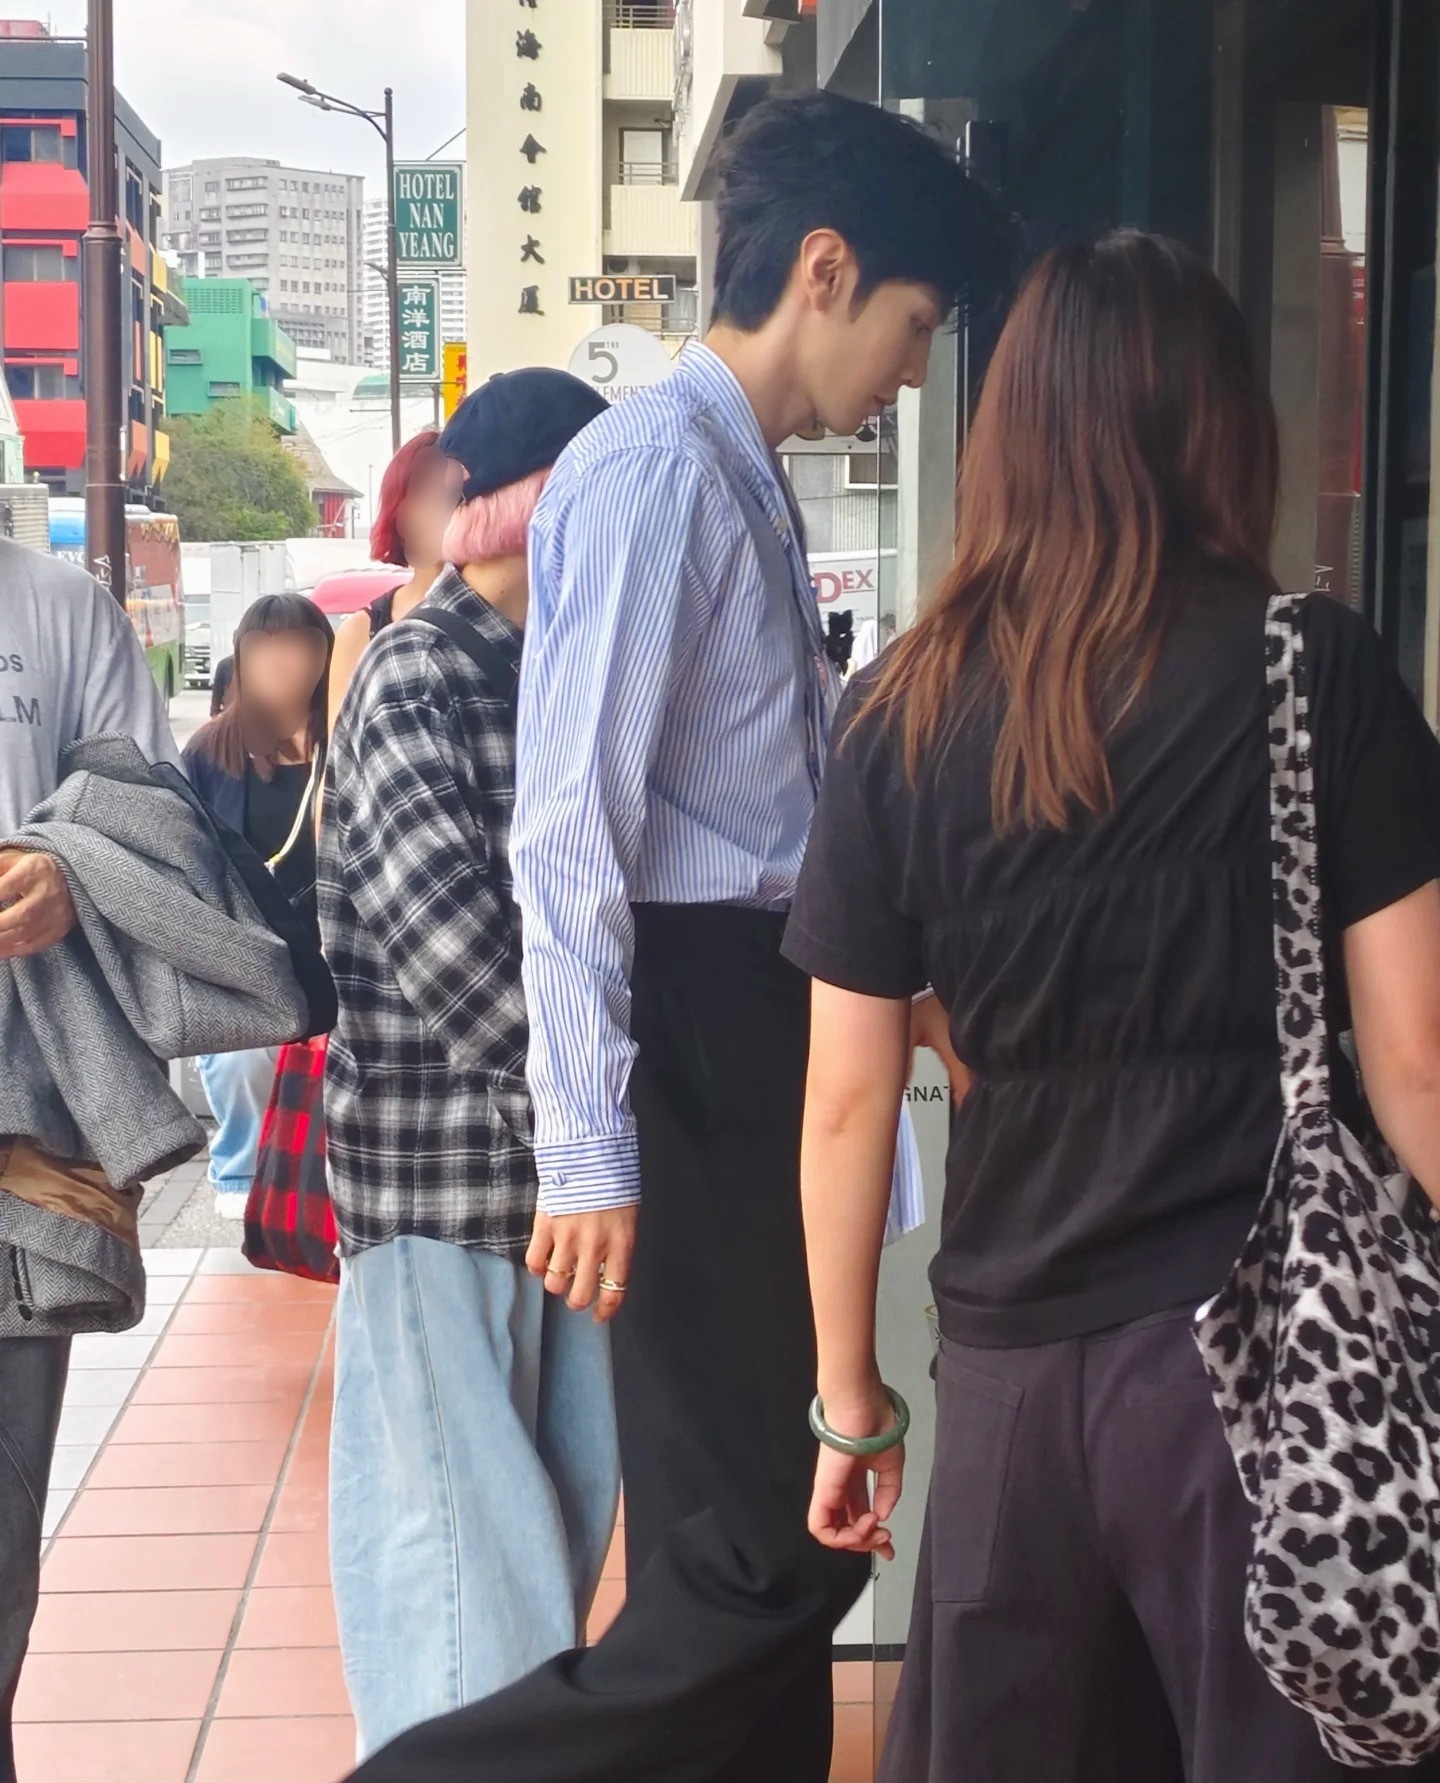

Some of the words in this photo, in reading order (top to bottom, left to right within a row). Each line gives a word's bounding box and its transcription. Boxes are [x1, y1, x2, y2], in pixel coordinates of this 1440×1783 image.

[399, 172, 455, 200] HOTEL
[409, 202, 444, 229] NAN
[399, 231, 455, 258] YEANG
[575, 278, 669, 300] HOTEL
[401, 285, 431, 372] 南洋酒店
[588, 341, 619, 384] 5
